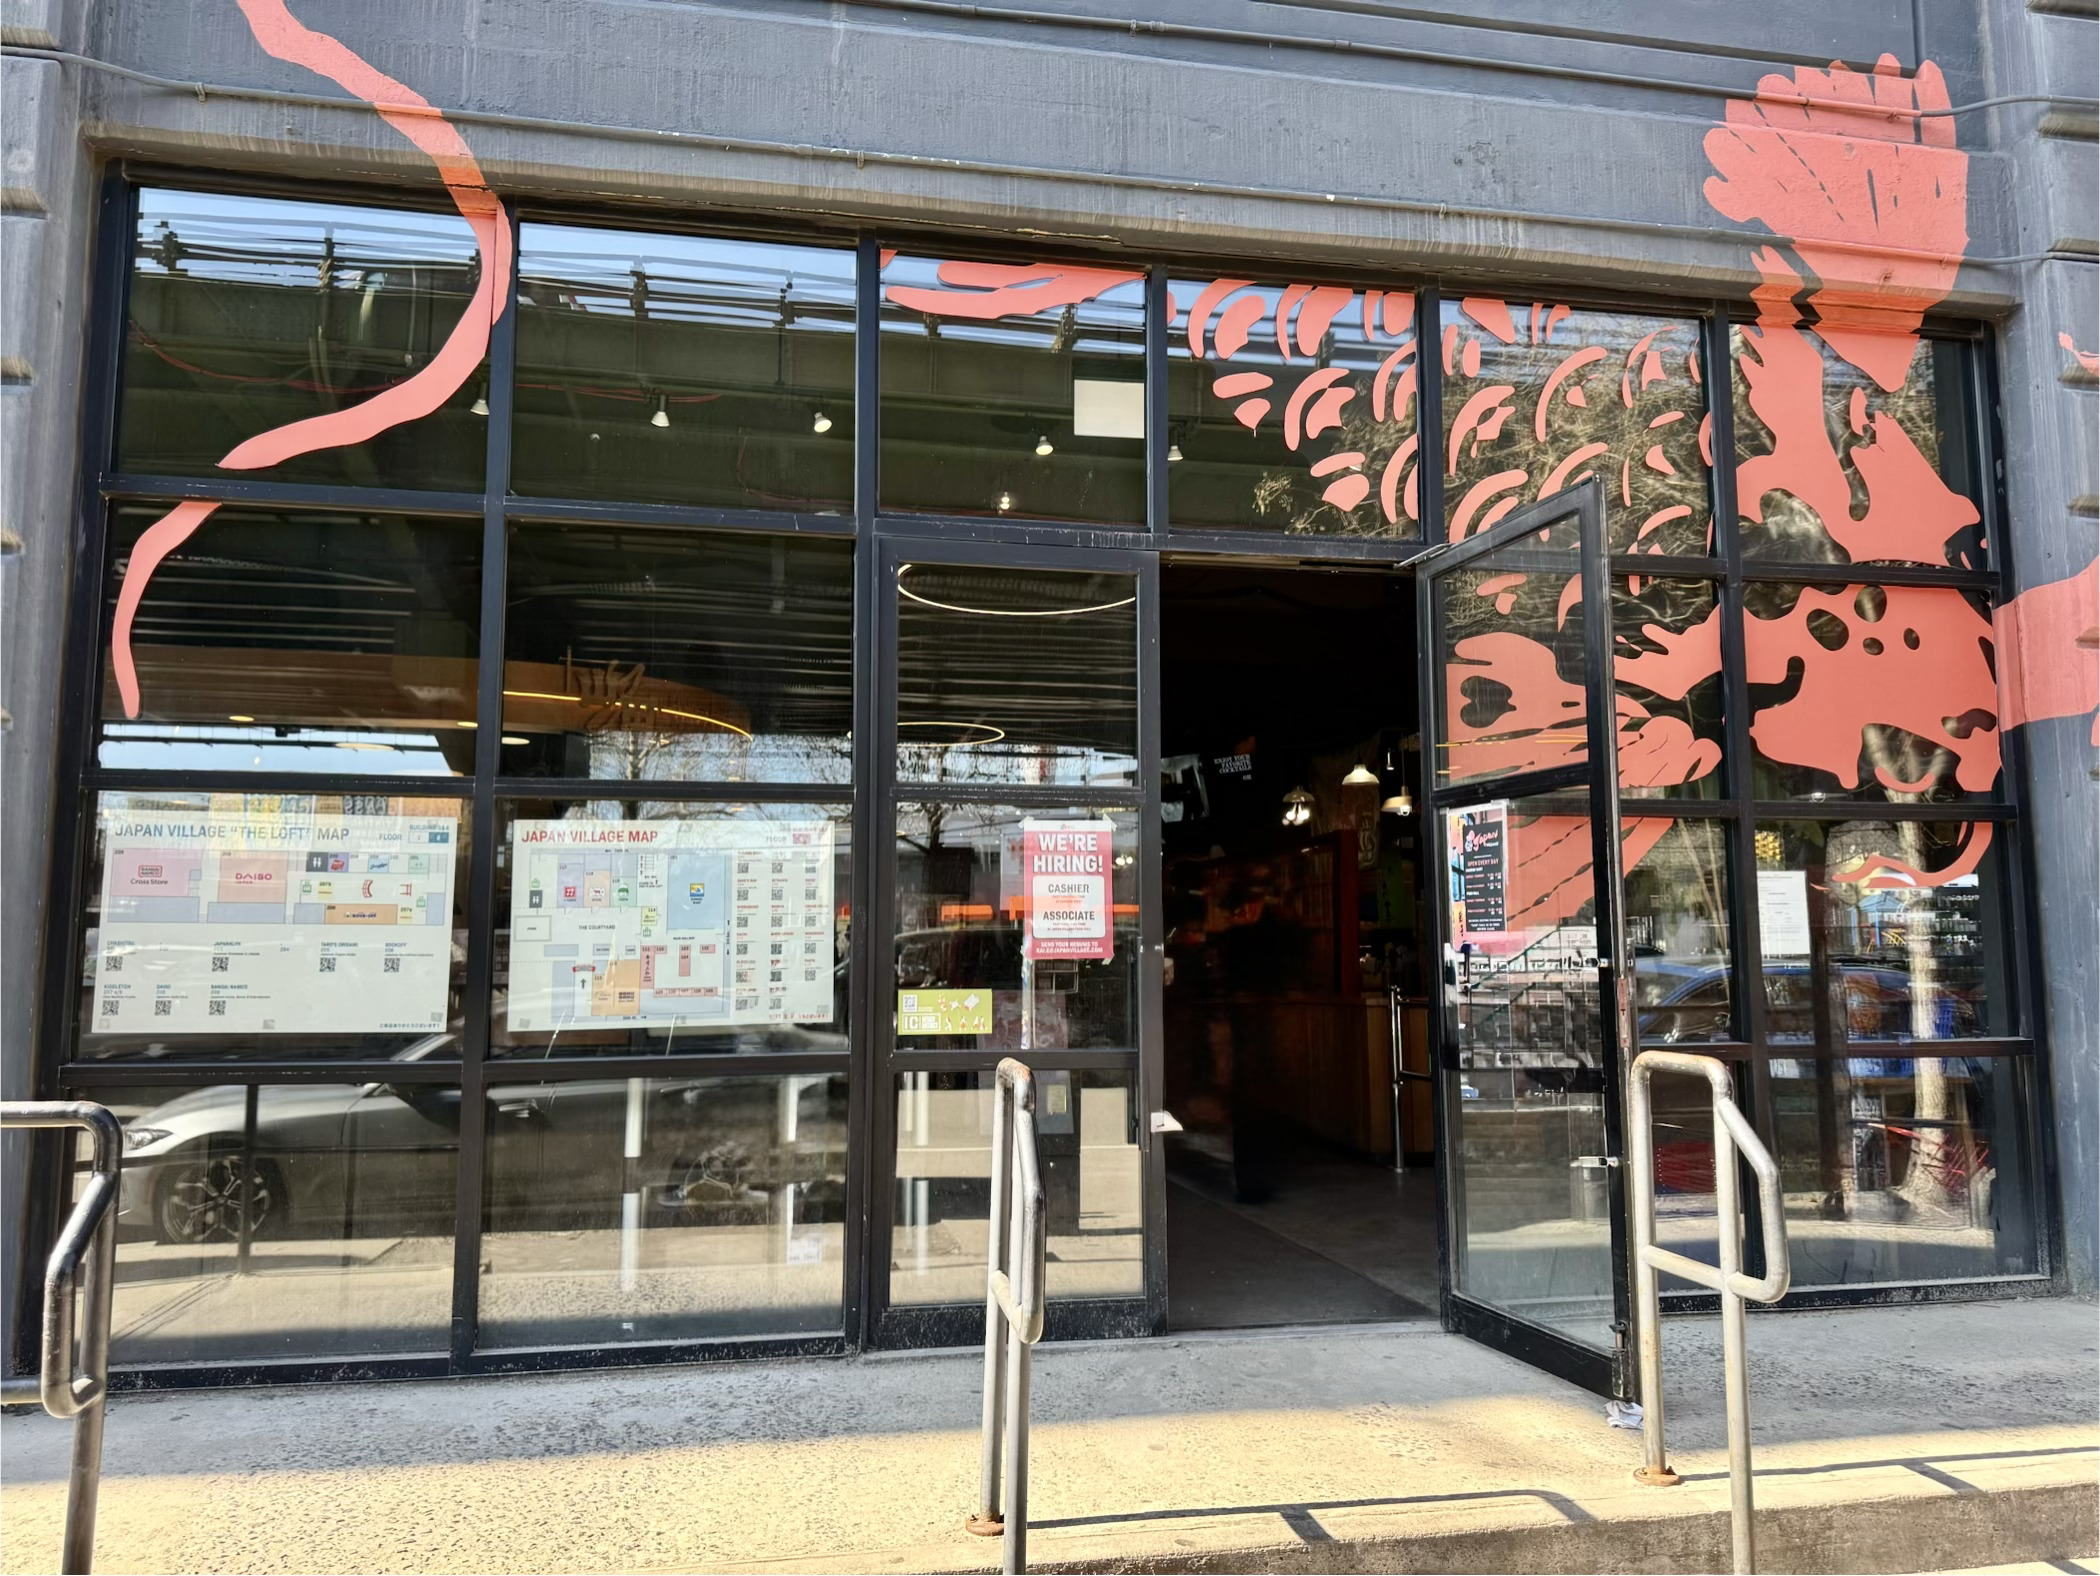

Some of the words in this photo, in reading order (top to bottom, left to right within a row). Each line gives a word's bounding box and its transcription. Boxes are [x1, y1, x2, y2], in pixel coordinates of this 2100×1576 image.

[115, 824, 163, 837] JAPAN
[168, 825, 226, 838] VILLAGE
[317, 828, 350, 841] MAP
[522, 830, 566, 843] JAPAN
[570, 830, 625, 843] VILLAGE
[628, 831, 658, 843] MAP
[1039, 834, 1098, 852] WE'RE
[1033, 855, 1103, 873] HIRING!
[236, 872, 272, 881] DAISO
[1048, 884, 1090, 894] CASHIER
[1043, 911, 1095, 921] ASSOCIATE
[904, 1016, 919, 1030] IC
